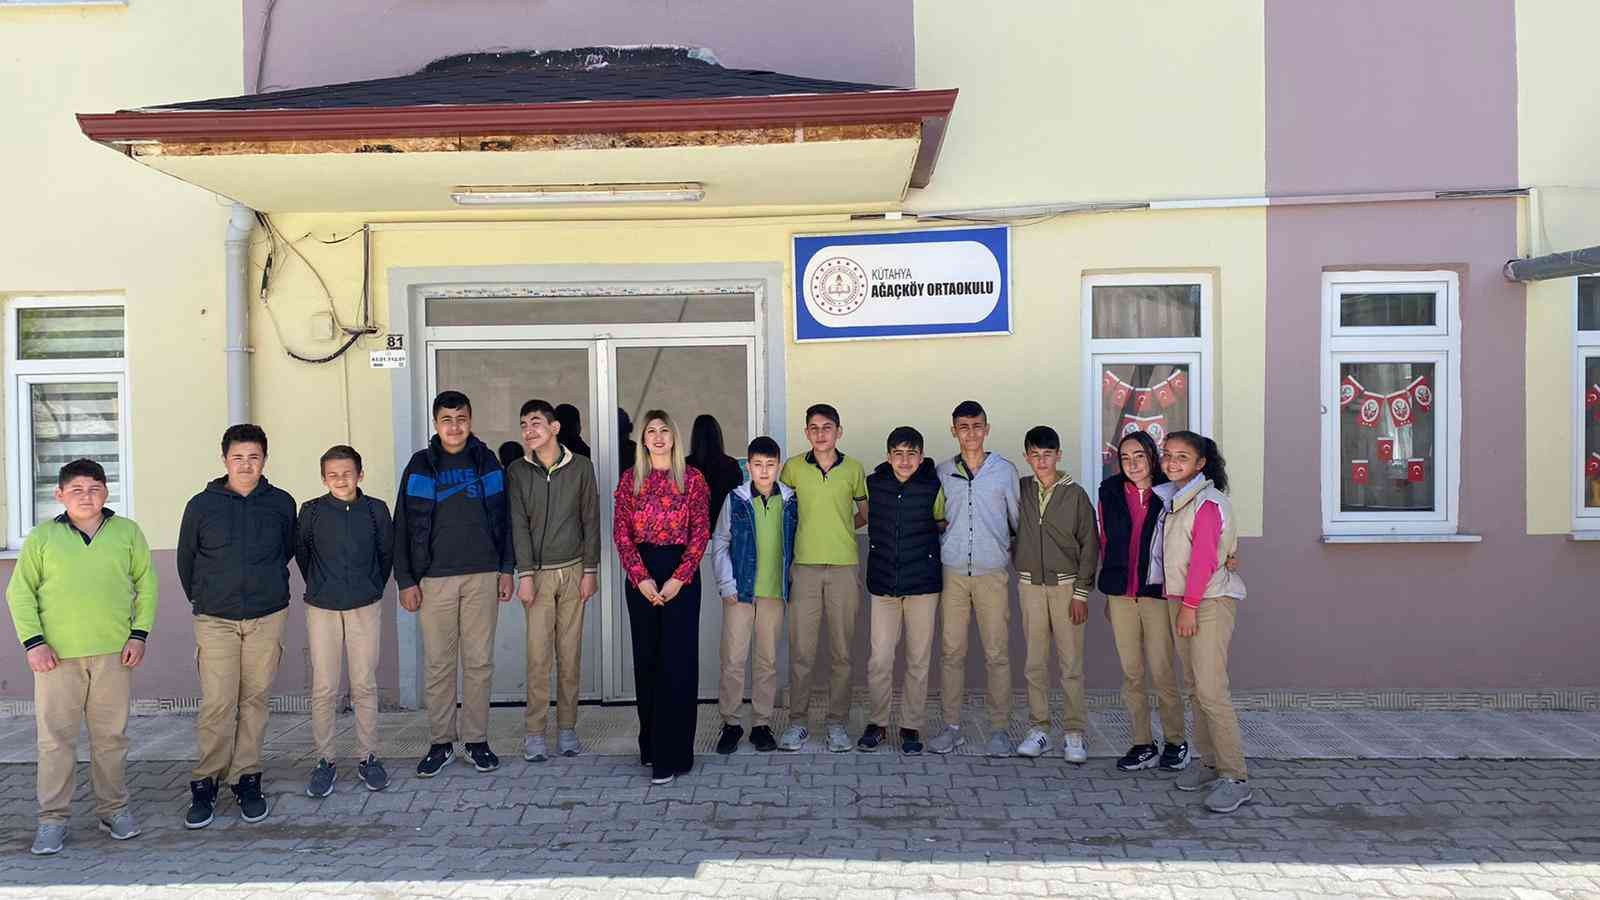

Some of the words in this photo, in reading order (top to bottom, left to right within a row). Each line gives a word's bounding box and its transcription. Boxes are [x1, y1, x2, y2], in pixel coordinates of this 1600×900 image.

[871, 266, 912, 280] KÜTAHYA
[871, 281, 925, 300] AĞAÇKÖY
[926, 280, 994, 297] ORTAOKULU
[387, 336, 403, 347] 81
